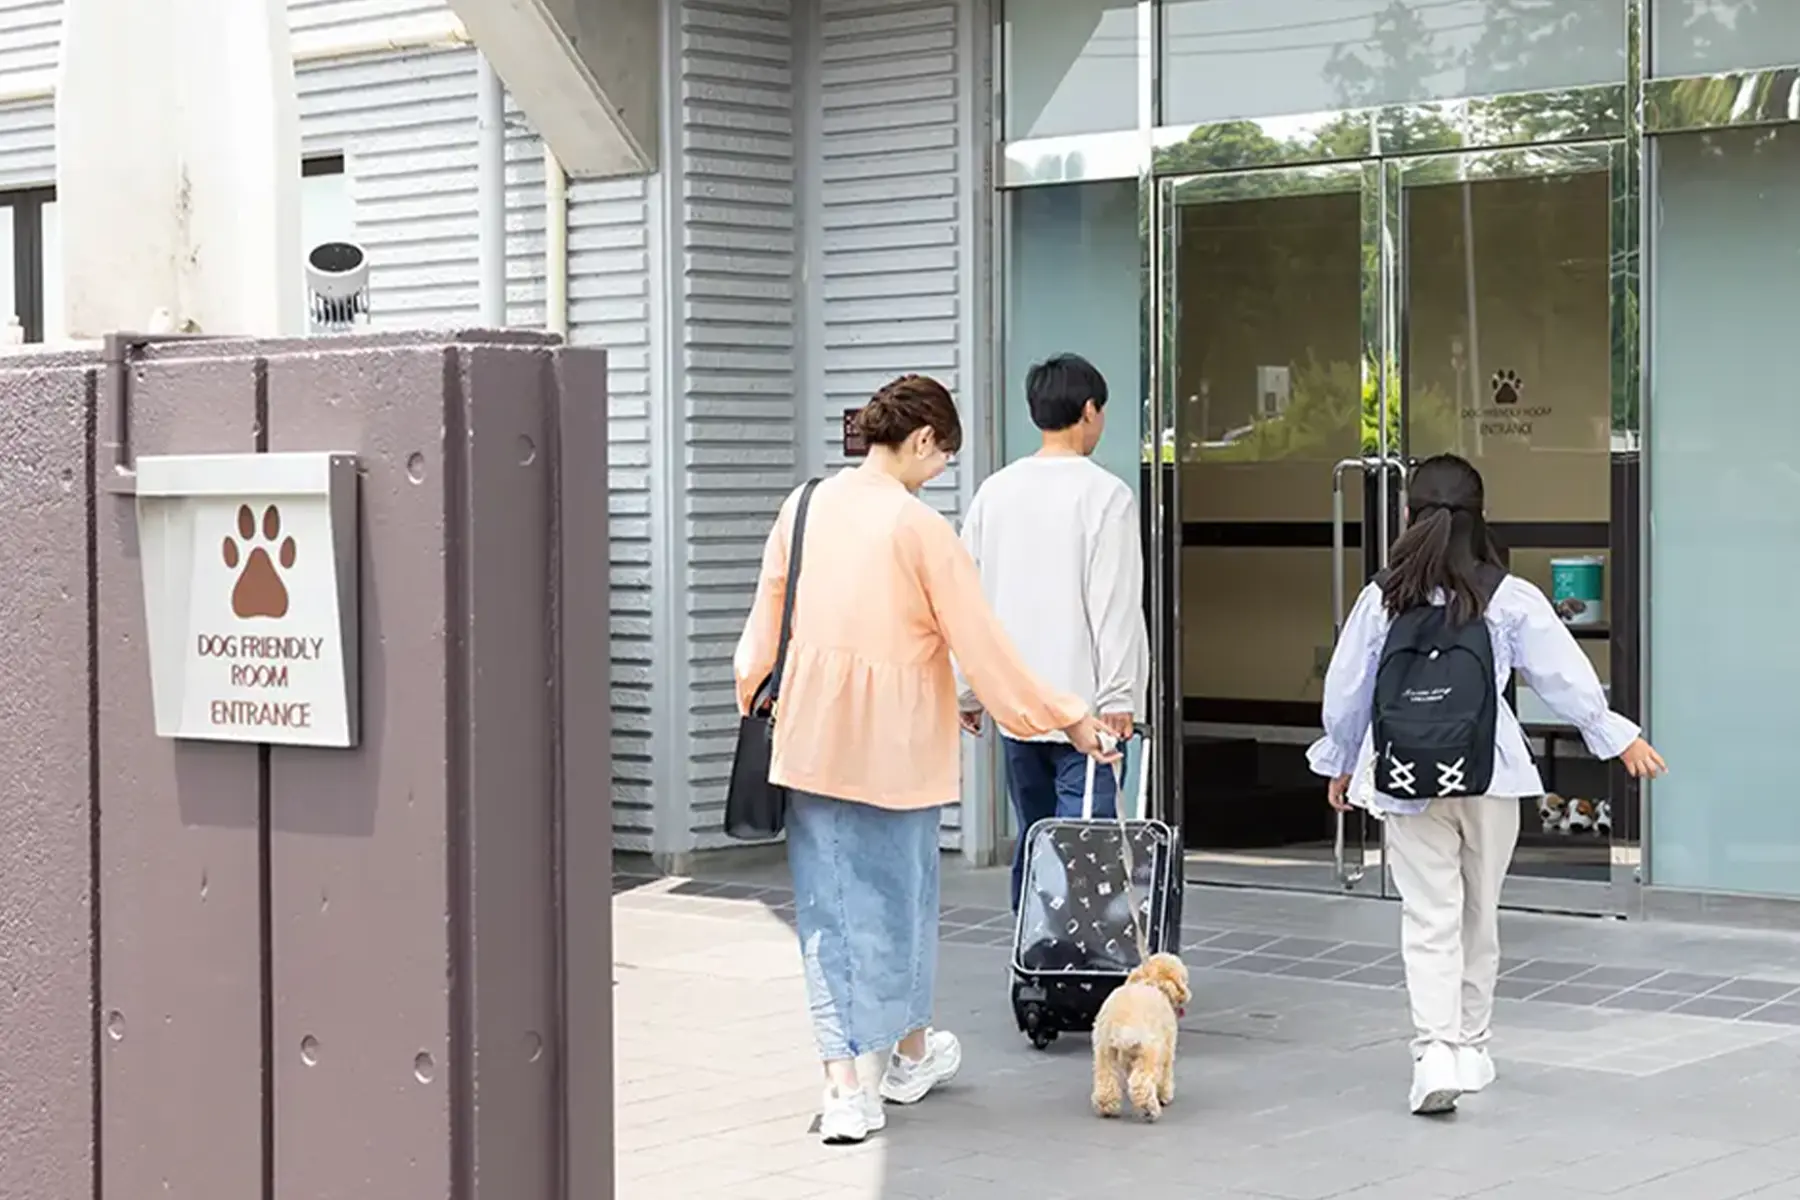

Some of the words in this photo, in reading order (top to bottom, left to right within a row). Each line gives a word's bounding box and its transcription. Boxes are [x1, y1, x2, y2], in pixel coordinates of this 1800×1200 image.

[198, 634, 237, 657] DOG
[241, 636, 324, 660] FRIENDLY
[231, 664, 289, 688] ROOM
[210, 699, 312, 728] ENTRANCE
